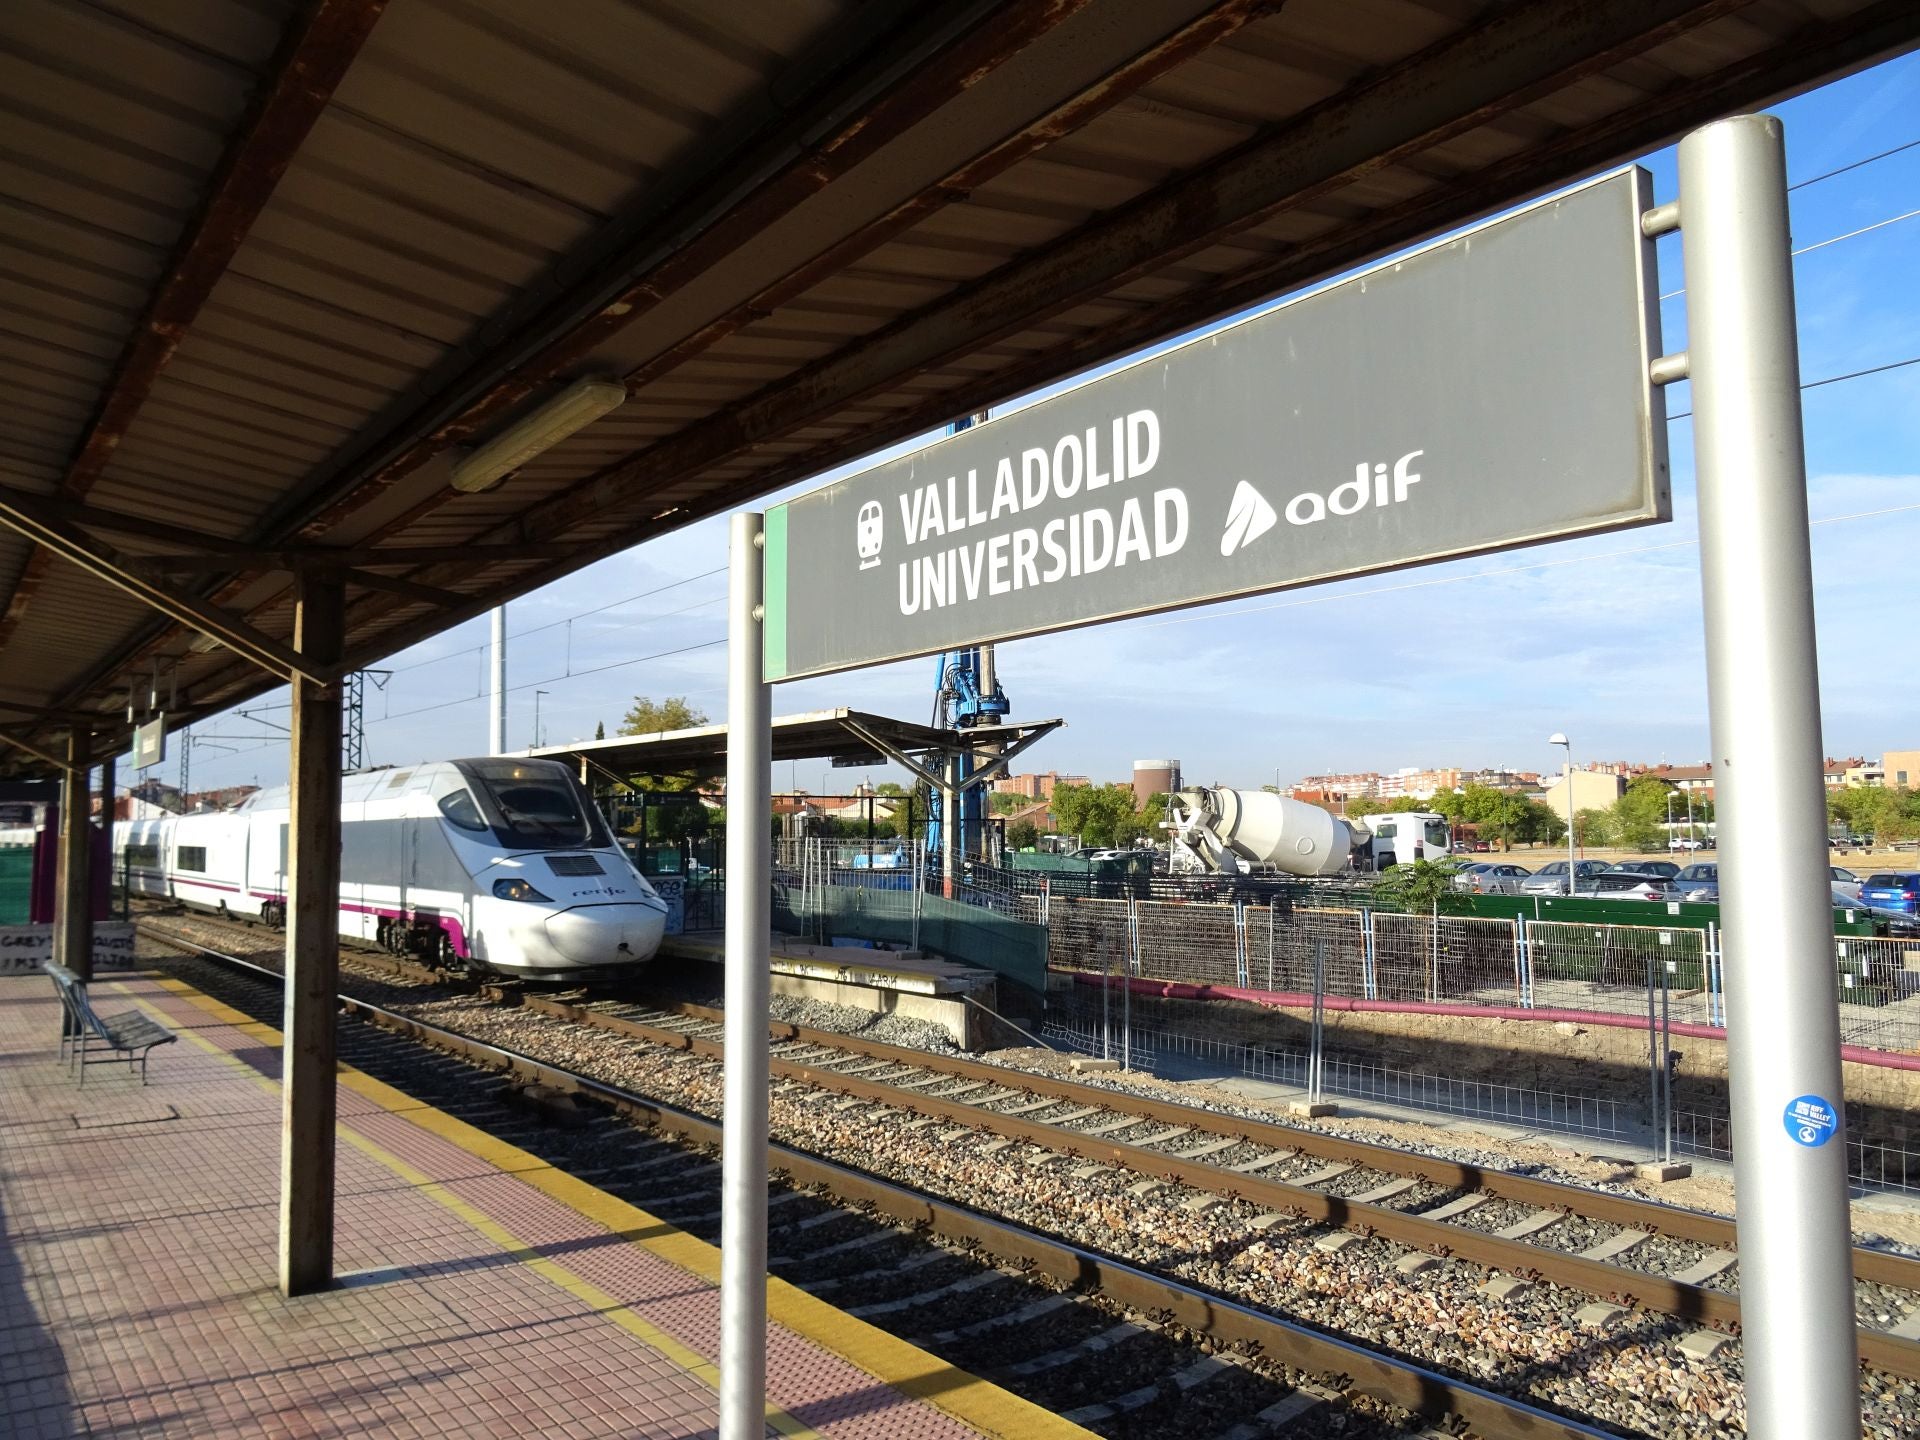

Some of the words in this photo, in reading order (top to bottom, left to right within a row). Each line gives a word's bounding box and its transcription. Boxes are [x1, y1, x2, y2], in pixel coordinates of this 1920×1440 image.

[899, 409, 1160, 545] VALLADOLID
[1284, 449, 1424, 526] adif
[899, 487, 1189, 616] UNIVERSIDAD
[572, 887, 626, 897] renfe
